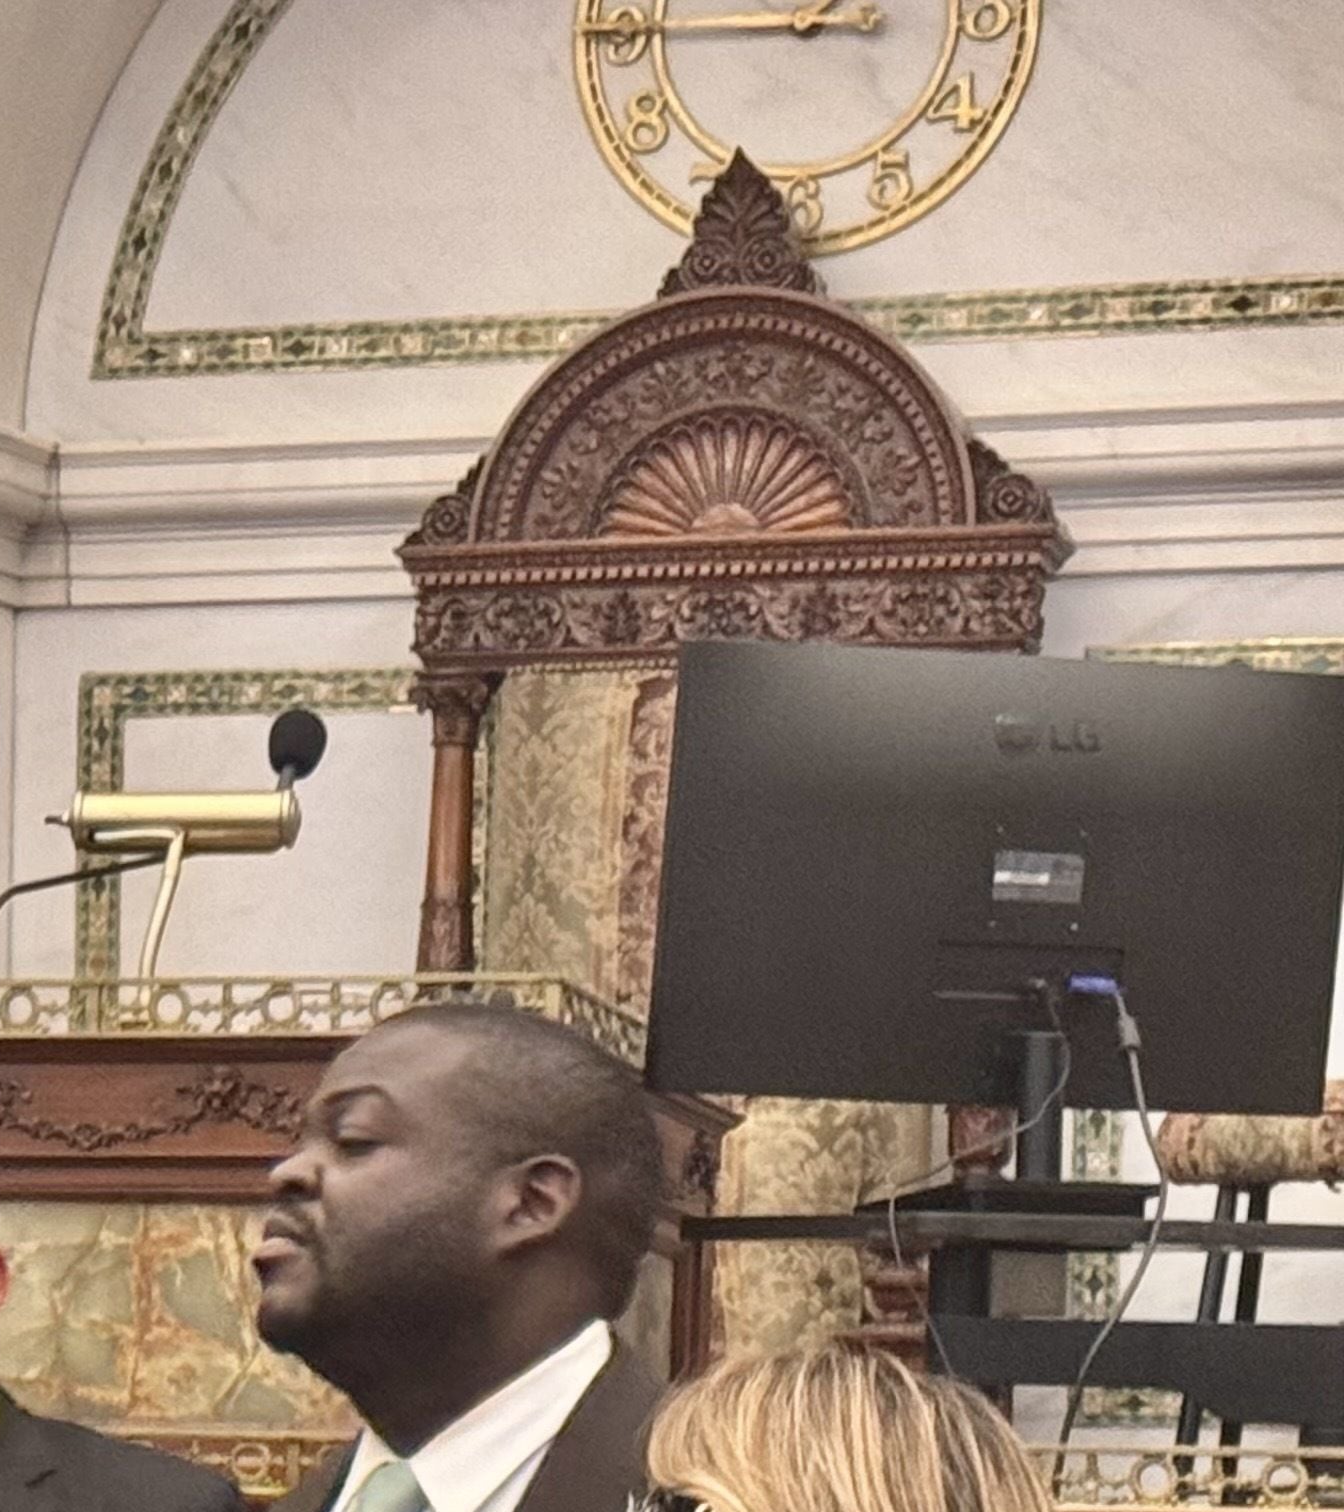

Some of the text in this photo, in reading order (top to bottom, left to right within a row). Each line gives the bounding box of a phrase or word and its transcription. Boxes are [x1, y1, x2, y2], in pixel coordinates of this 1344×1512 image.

[625, 90, 669, 153] 8
[926, 73, 987, 132] 4
[866, 150, 911, 211] 5
[1049, 721, 1102, 751] LG
